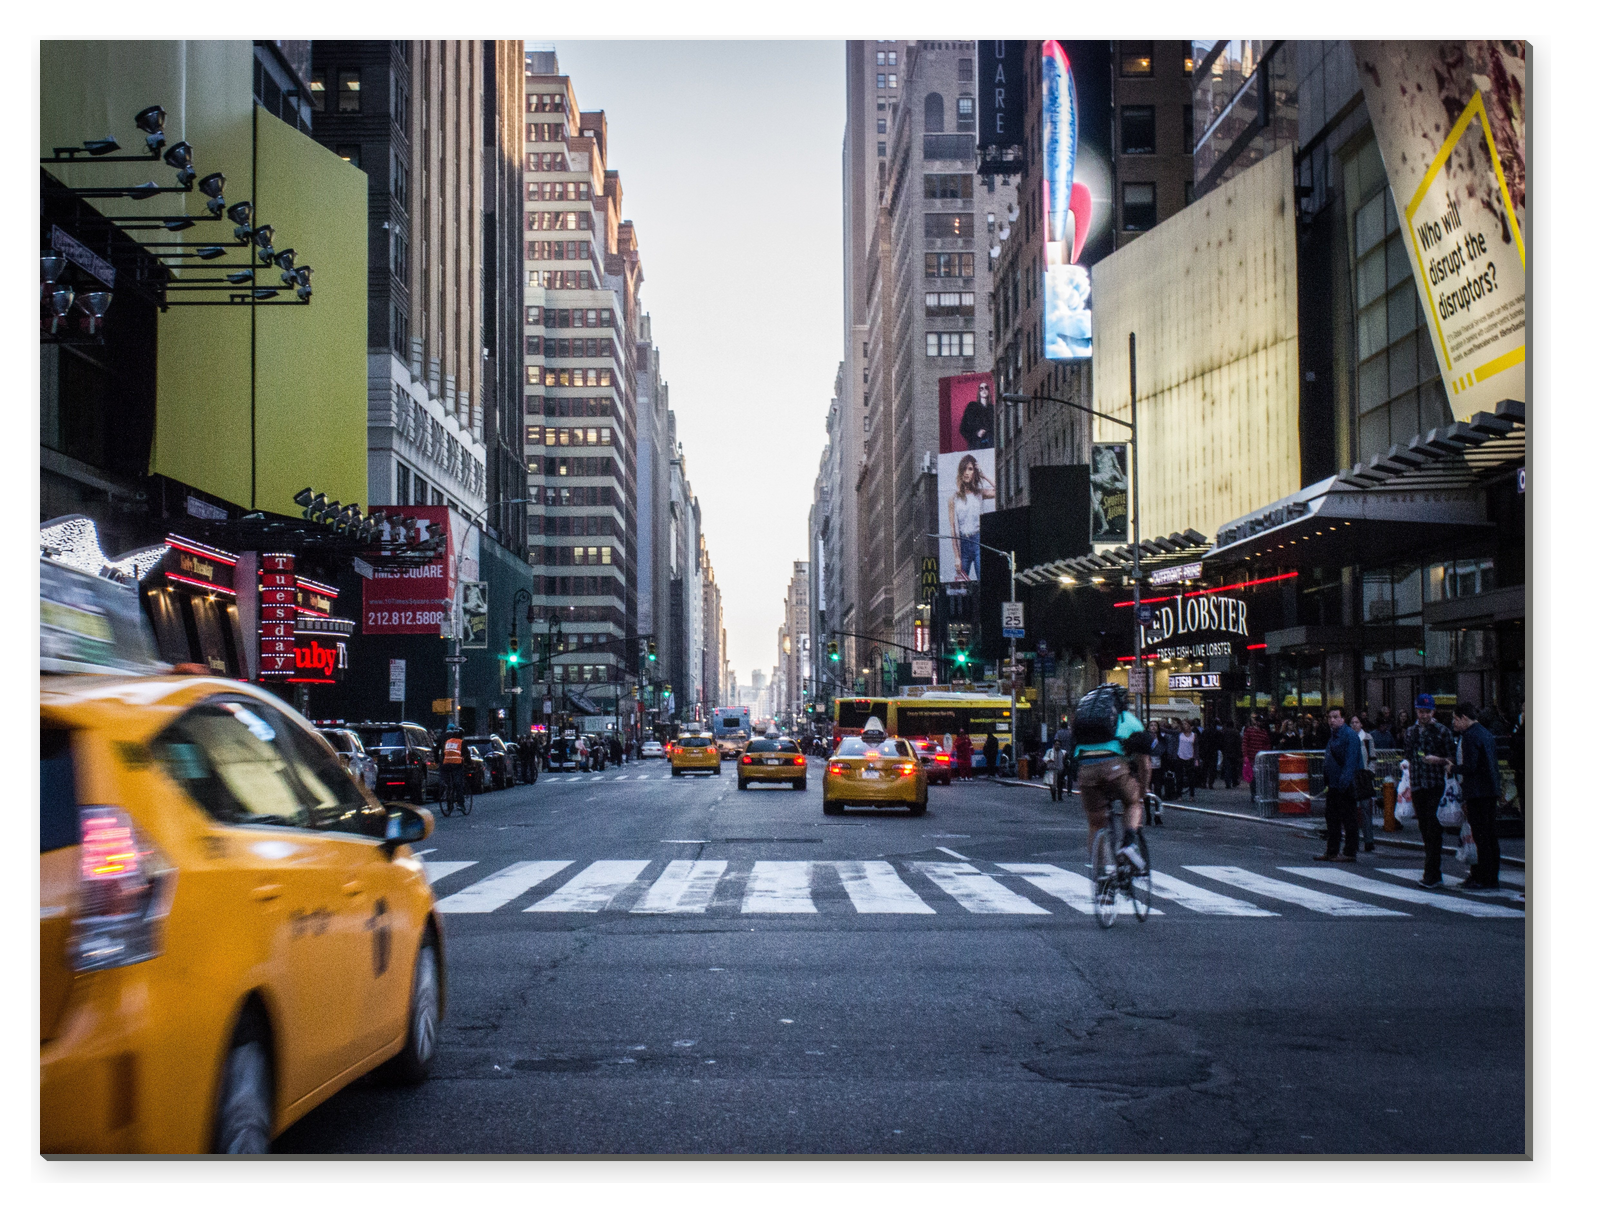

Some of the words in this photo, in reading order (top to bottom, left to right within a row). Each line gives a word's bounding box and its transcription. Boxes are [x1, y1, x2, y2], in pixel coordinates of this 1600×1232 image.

[1417, 221, 1442, 252] Who
[1441, 191, 1462, 235] will
[1429, 241, 1466, 287] disrupt
[1464, 232, 1487, 261] the
[1439, 261, 1498, 321] disruptors?
[274, 558, 287, 670] Tuesday
[368, 611, 443, 625] 212.812.5808
[1005, 616, 1021, 626] 25
[1177, 595, 1248, 636] LOBSTER
[293, 641, 337, 675] uby
[1193, 645, 1205, 656] LIVE
[1206, 642, 1232, 655] LOBSTER
[1175, 676, 1193, 688] FISH
